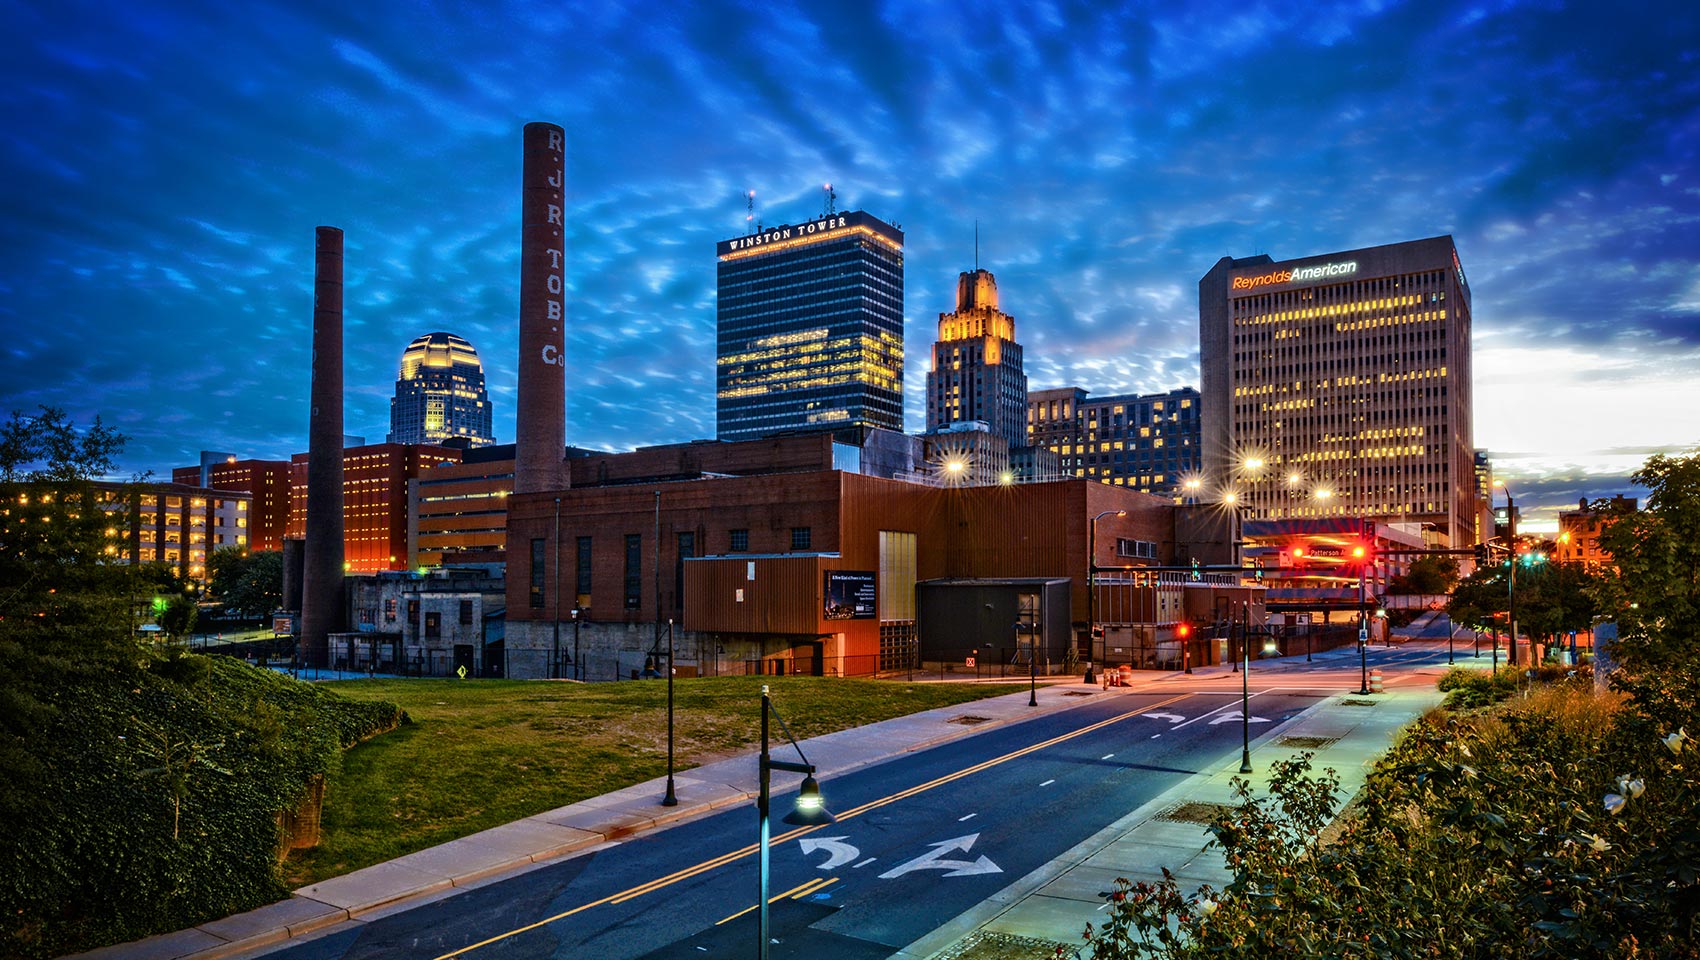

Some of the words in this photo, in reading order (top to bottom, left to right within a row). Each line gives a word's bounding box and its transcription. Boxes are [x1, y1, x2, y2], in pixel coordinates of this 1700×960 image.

[730, 229, 791, 250] WINSTON
[798, 217, 846, 236] TOWER
[1310, 549, 1340, 557] Patterson
